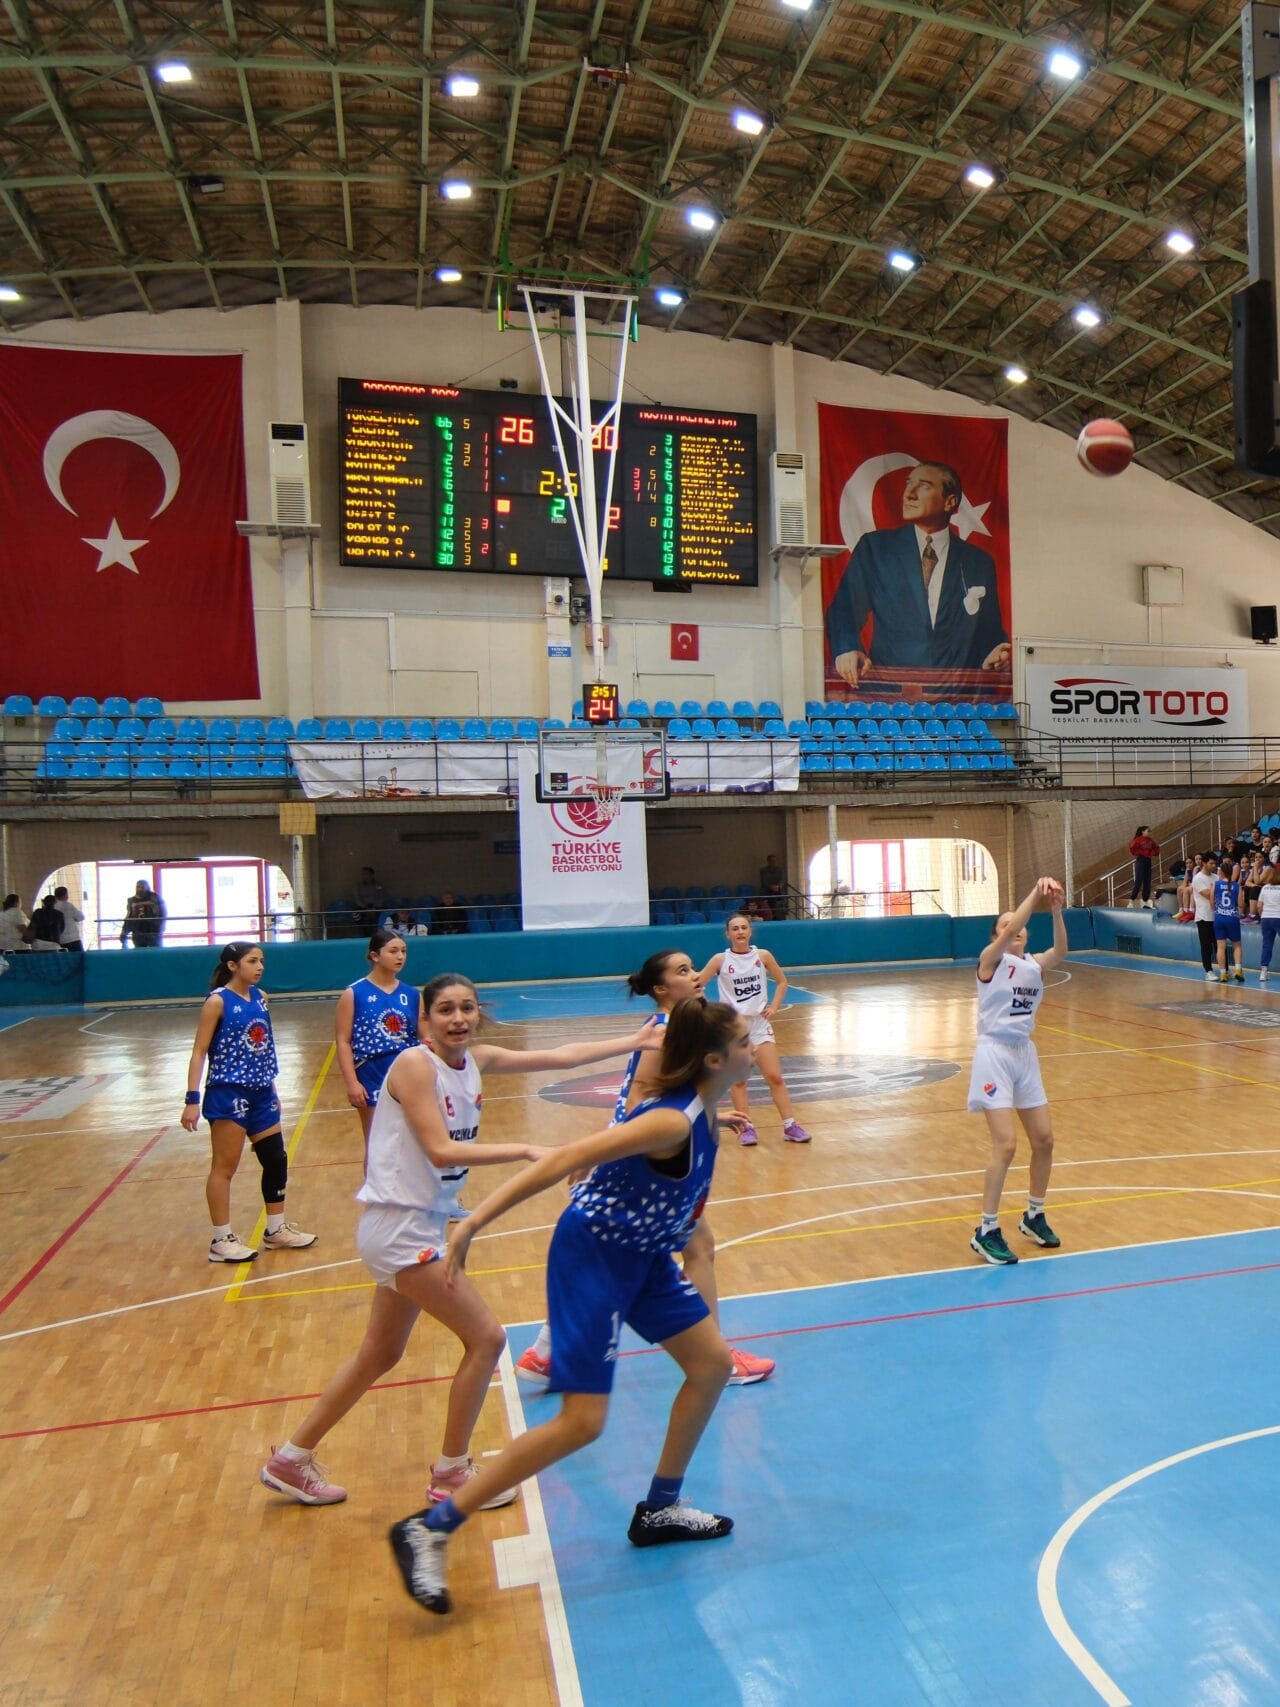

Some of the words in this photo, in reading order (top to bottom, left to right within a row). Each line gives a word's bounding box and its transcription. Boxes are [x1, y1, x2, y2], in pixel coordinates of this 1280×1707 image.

[463, 418, 470, 430] 5
[501, 417, 533, 443] 26
[665, 434, 673, 446] 3
[463, 442, 471, 454] 3
[649, 445, 657, 456] 2
[665, 446, 673, 457] 4
[444, 454, 453, 466] 2
[463, 455, 471, 467] 2
[665, 458, 673, 469] 5
[445, 466, 453, 478] 5
[633, 467, 641, 479] 3
[649, 469, 657, 480] 5
[444, 478, 453, 490] 6
[633, 479, 641, 491] 3
[446, 491, 453, 502] 7
[649, 493, 657, 503] 4
[664, 493, 673, 505] 8
[444, 503, 453, 515] 8
[552, 498, 565, 517] 2
[463, 517, 471, 529] 3
[481, 518, 489, 530] 3
[650, 516, 657, 528] 8
[464, 529, 471, 541] 5
[464, 542, 471, 553] 5
[481, 543, 489, 555] 2
[439, 552, 453, 565] 30
[464, 554, 471, 566] 3
[592, 686, 616, 697] 2:51
[590, 699, 613, 718] 24
[552, 839, 622, 855] TÜRKİYE
[552, 855, 622, 865] BASKETBOL
[552, 864, 622, 873] FEDERASYONU
[1221, 890, 1231, 908] 6
[728, 964, 735, 974] 6
[1008, 965, 1016, 979] 7
[399, 993, 409, 1006] 0
